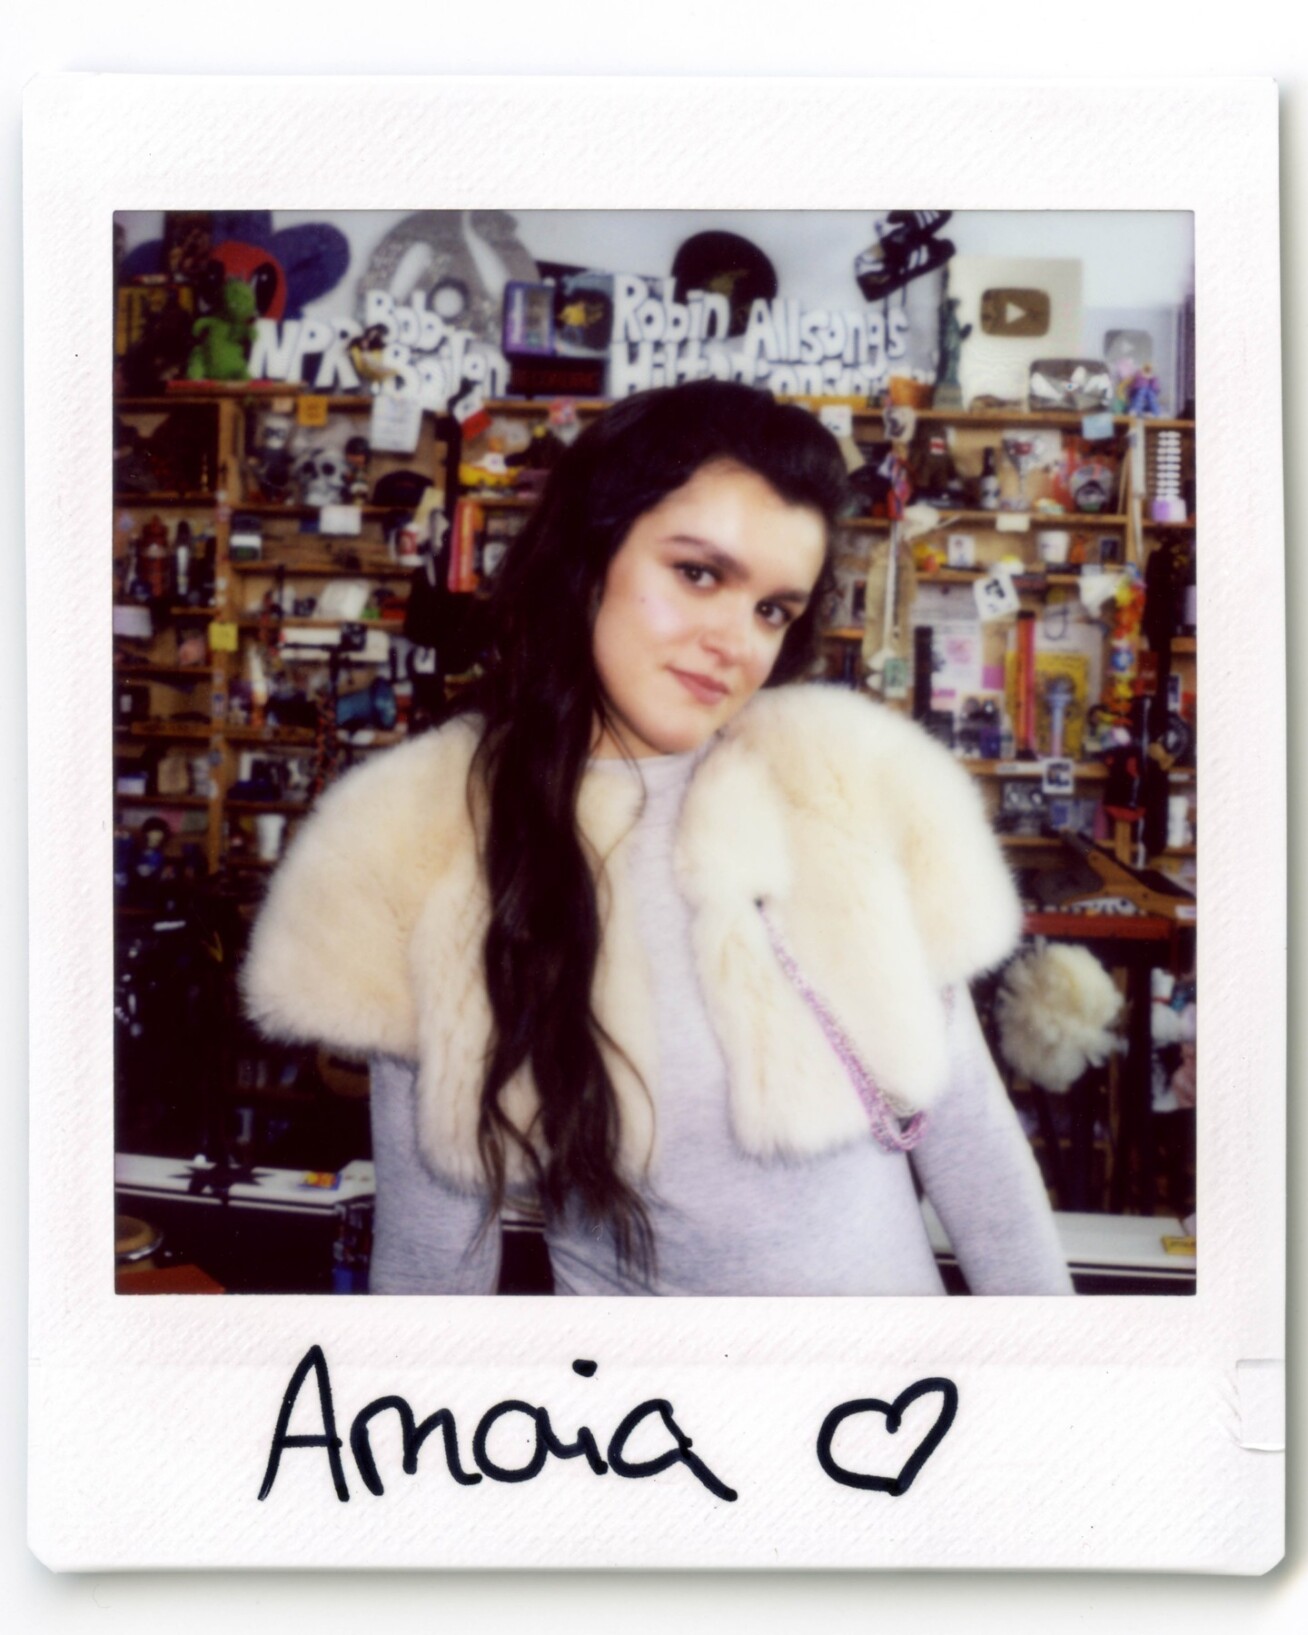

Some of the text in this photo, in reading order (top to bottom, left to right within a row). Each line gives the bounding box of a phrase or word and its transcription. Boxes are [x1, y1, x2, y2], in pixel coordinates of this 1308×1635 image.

[366, 290, 444, 350] Bob
[613, 274, 730, 342] Robin
[248, 318, 361, 389] NPR
[258, 1345, 737, 1502] Amaia
